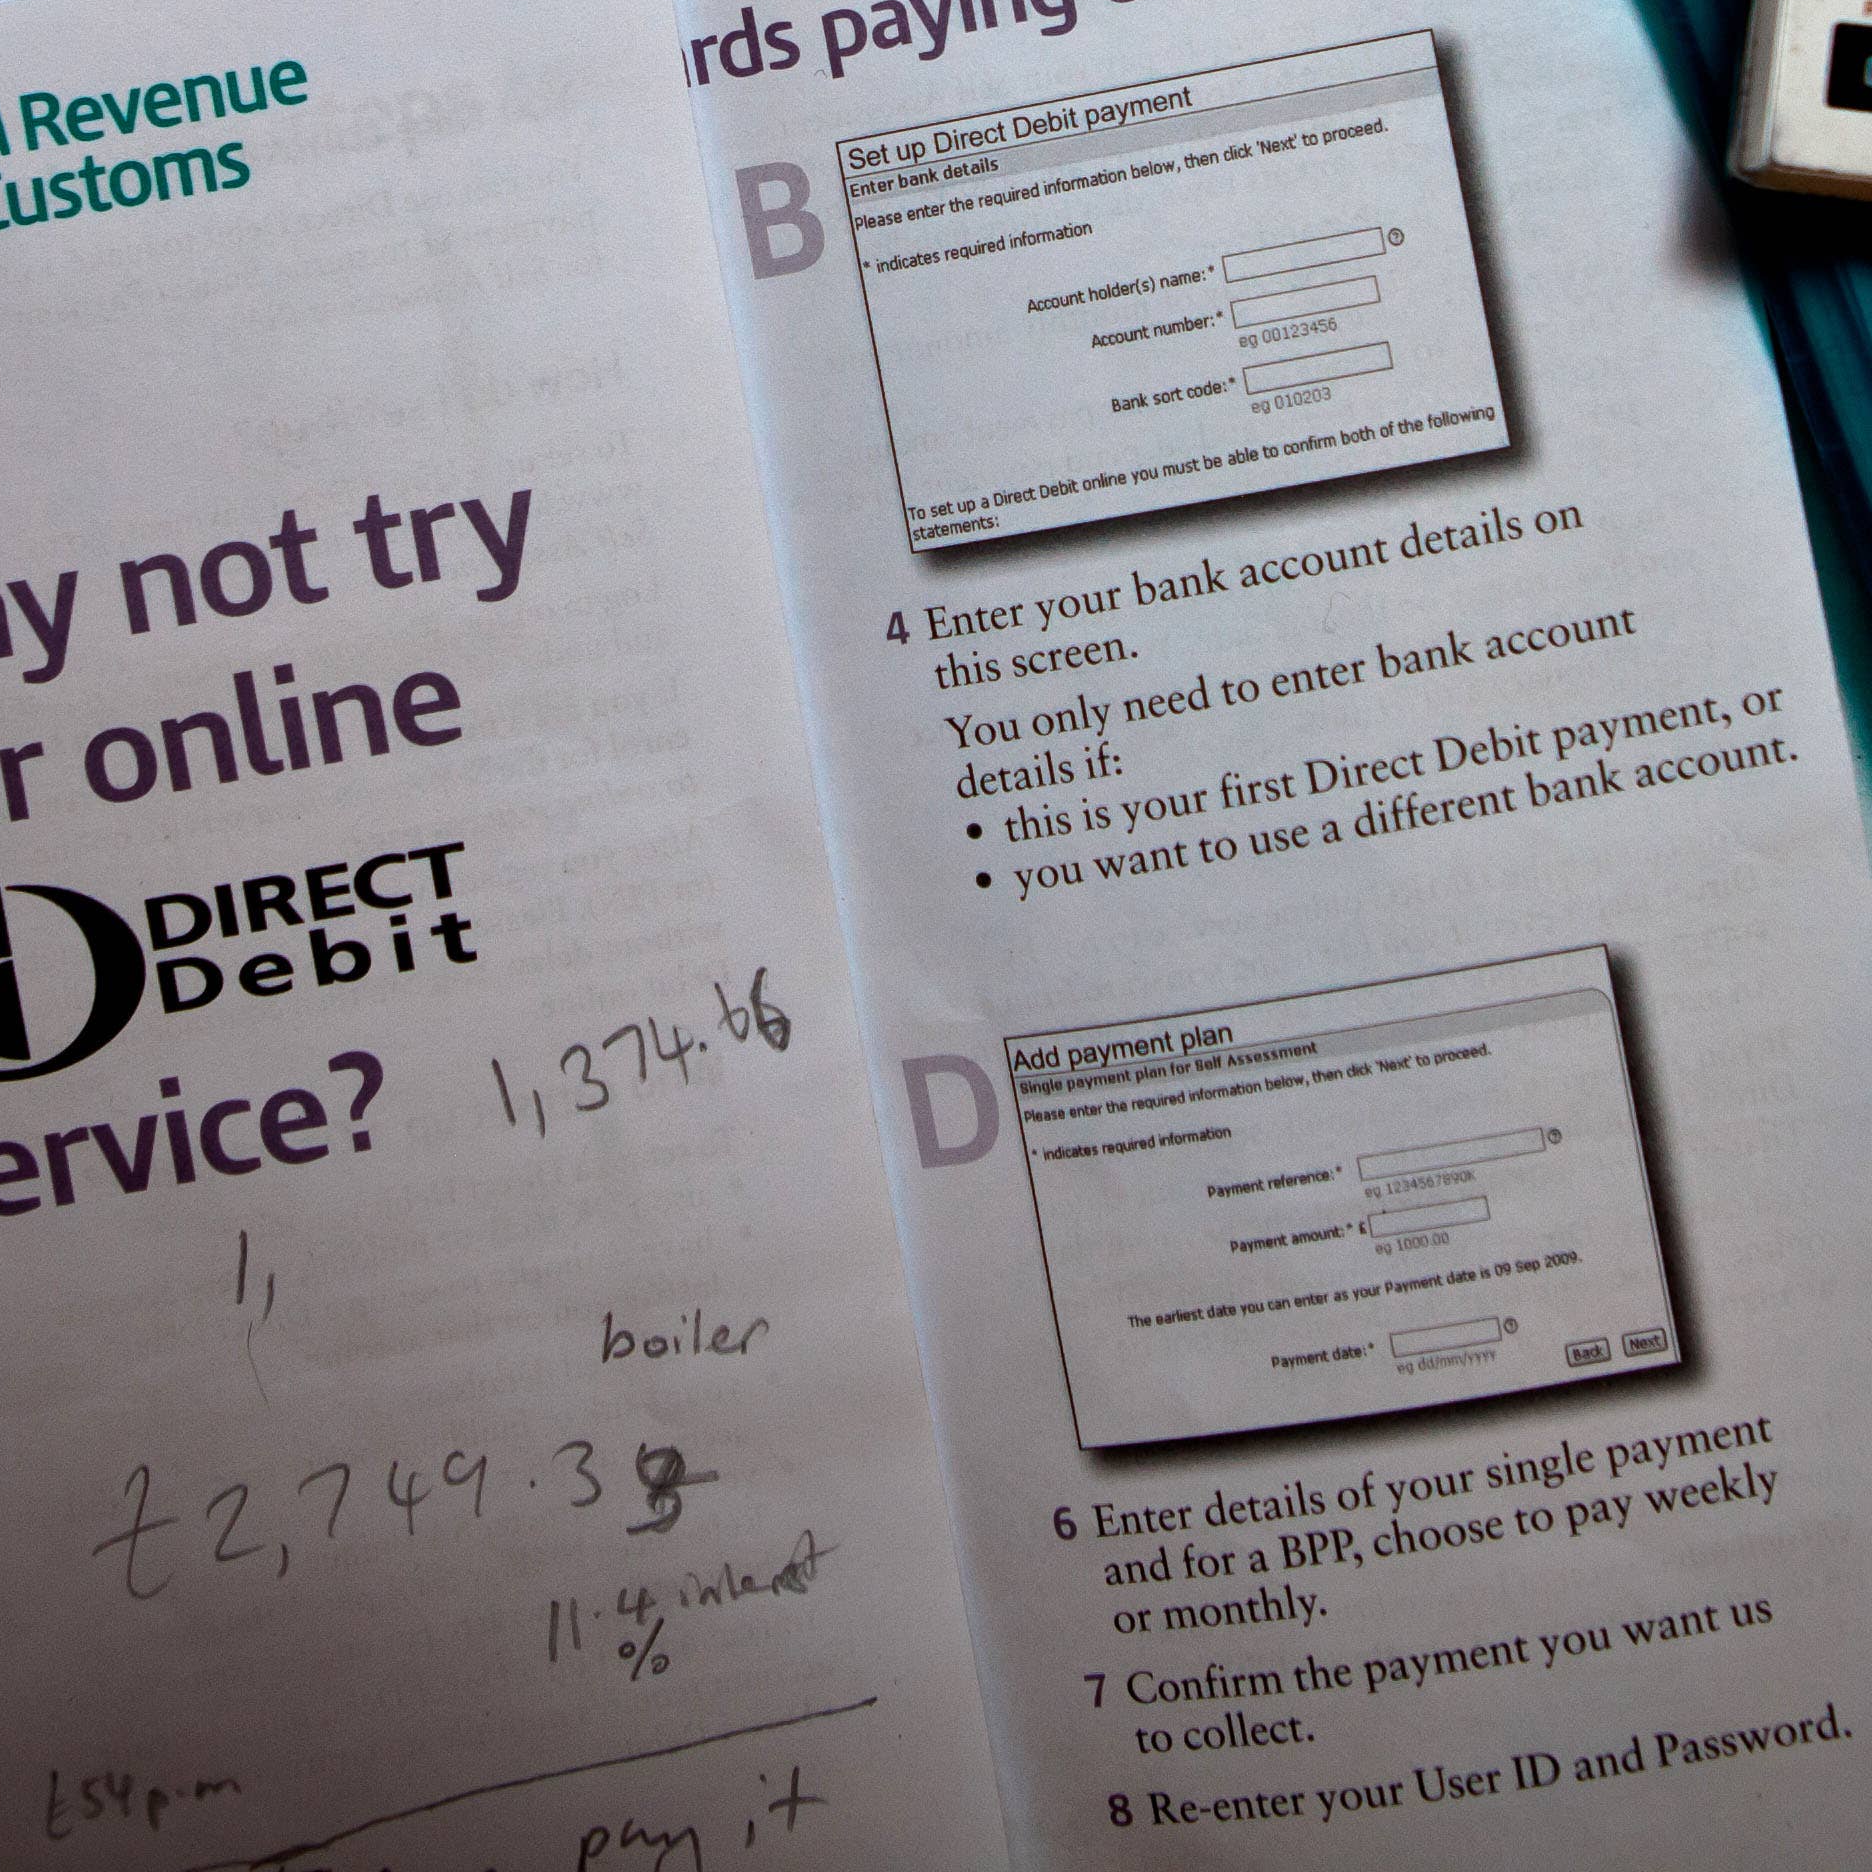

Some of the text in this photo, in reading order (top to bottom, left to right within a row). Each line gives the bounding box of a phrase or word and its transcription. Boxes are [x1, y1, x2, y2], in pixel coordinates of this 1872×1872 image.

[19, 60, 307, 150] Revenue
[848, 86, 1194, 169] Set up Direct Debit payment
[735, 161, 824, 279] B
[119, 509, 328, 634] not
[352, 489, 531, 602] try
[886, 506, 1583, 644] 4 Enter your bank account details on
[84, 663, 461, 803] online
[144, 841, 464, 950] DIRECT
[156, 912, 477, 1013] Debit
[900, 1053, 999, 1168] D
[601, 1308, 769, 1363] boiler
[1107, 1702, 1852, 1827] 8 Re-enter your User ID and Password.
